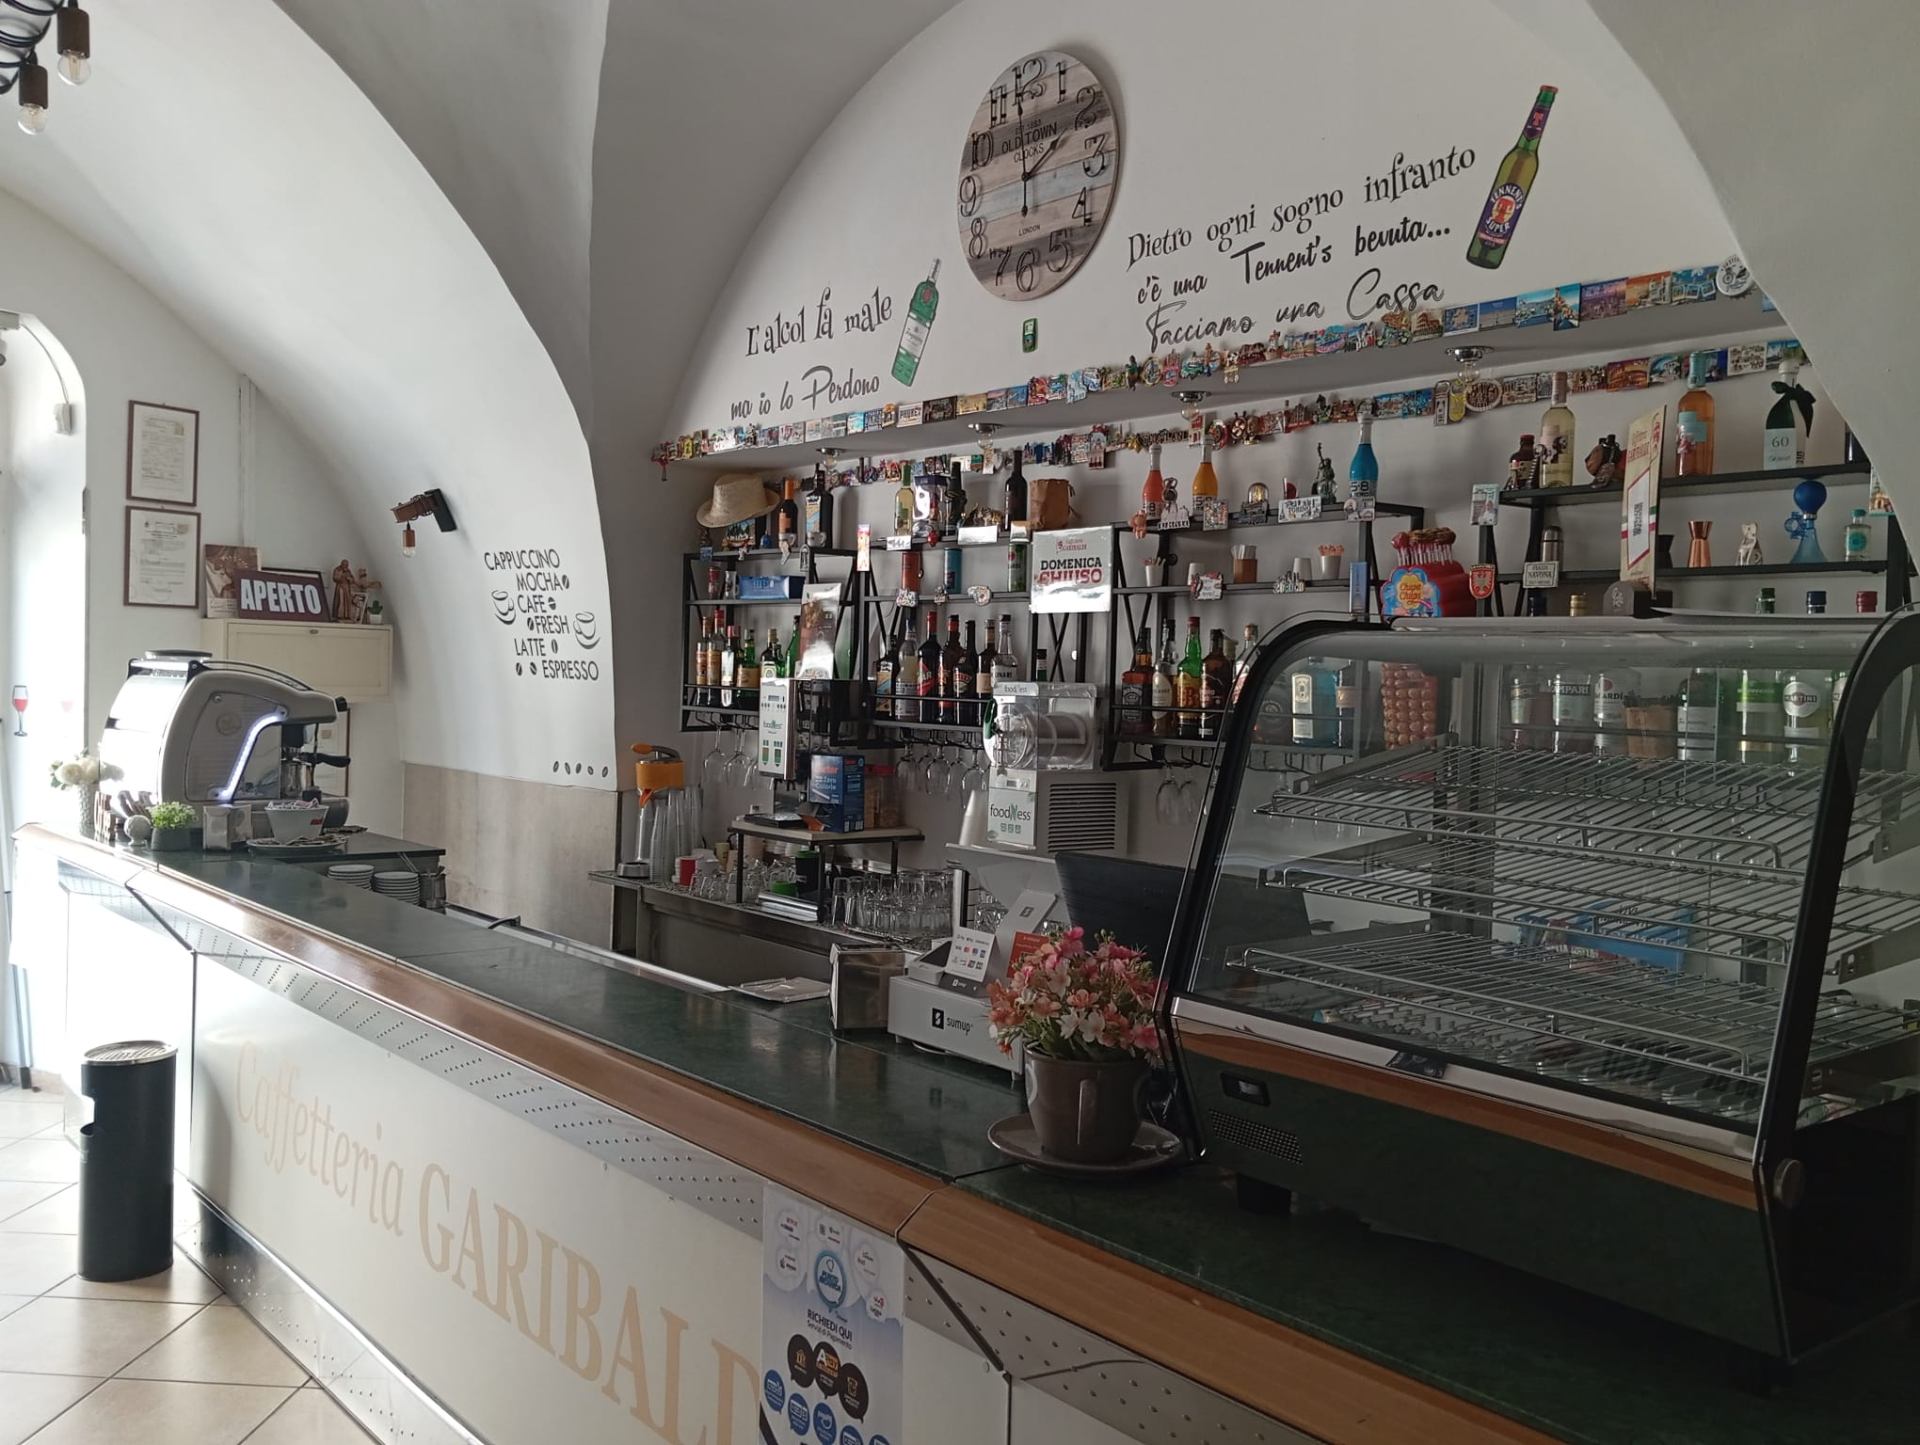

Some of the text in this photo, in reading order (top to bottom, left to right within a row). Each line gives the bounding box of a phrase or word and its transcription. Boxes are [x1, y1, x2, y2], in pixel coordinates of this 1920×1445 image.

[1012, 58, 1043, 106] 12
[1055, 60, 1067, 103] 1
[989, 87, 1008, 129] 11
[1074, 86, 1096, 131] 2
[970, 131, 993, 171] 10
[1002, 121, 1058, 154] OLD TOWN
[1013, 143, 1044, 164] CLOCKS
[1082, 134, 1106, 177] 3
[959, 176, 976, 217] 9
[1072, 186, 1093, 227] 4
[1126, 227, 1192, 272] Dietro
[1207, 204, 1256, 252] ogni
[1363, 145, 1476, 204] infranto
[968, 217, 984, 259] 8
[1018, 224, 1041, 237] LONDON
[1485, 216, 1511, 234] SUPER
[1016, 250, 1034, 292] 6
[1173, 273, 1207, 298] una
[1229, 235, 1333, 284] Tennent's
[1354, 216, 1451, 257] bevuta...
[745, 305, 806, 357] L'alcol
[844, 285, 892, 334] male
[1145, 267, 1445, 353] Facciamo una Cassa
[730, 365, 880, 421] ma io lo Perdono
[484, 548, 560, 571] CAPPUCCINO
[1040, 556, 1102, 571] DOMENICA
[240, 578, 322, 615] APERTO
[516, 571, 563, 592] MOCHA
[517, 594, 547, 613] CAFE
[534, 615, 570, 634] FRESH
[514, 638, 546, 656] LATTE
[542, 659, 599, 681] ESPRESSO
[990, 803, 1032, 821] foodNess
[946, 1017, 972, 1036] sumup
[235, 1040, 762, 1445] Caffetteria GARIBALD
[807, 1308, 853, 1342] RICHIEDI QUI
